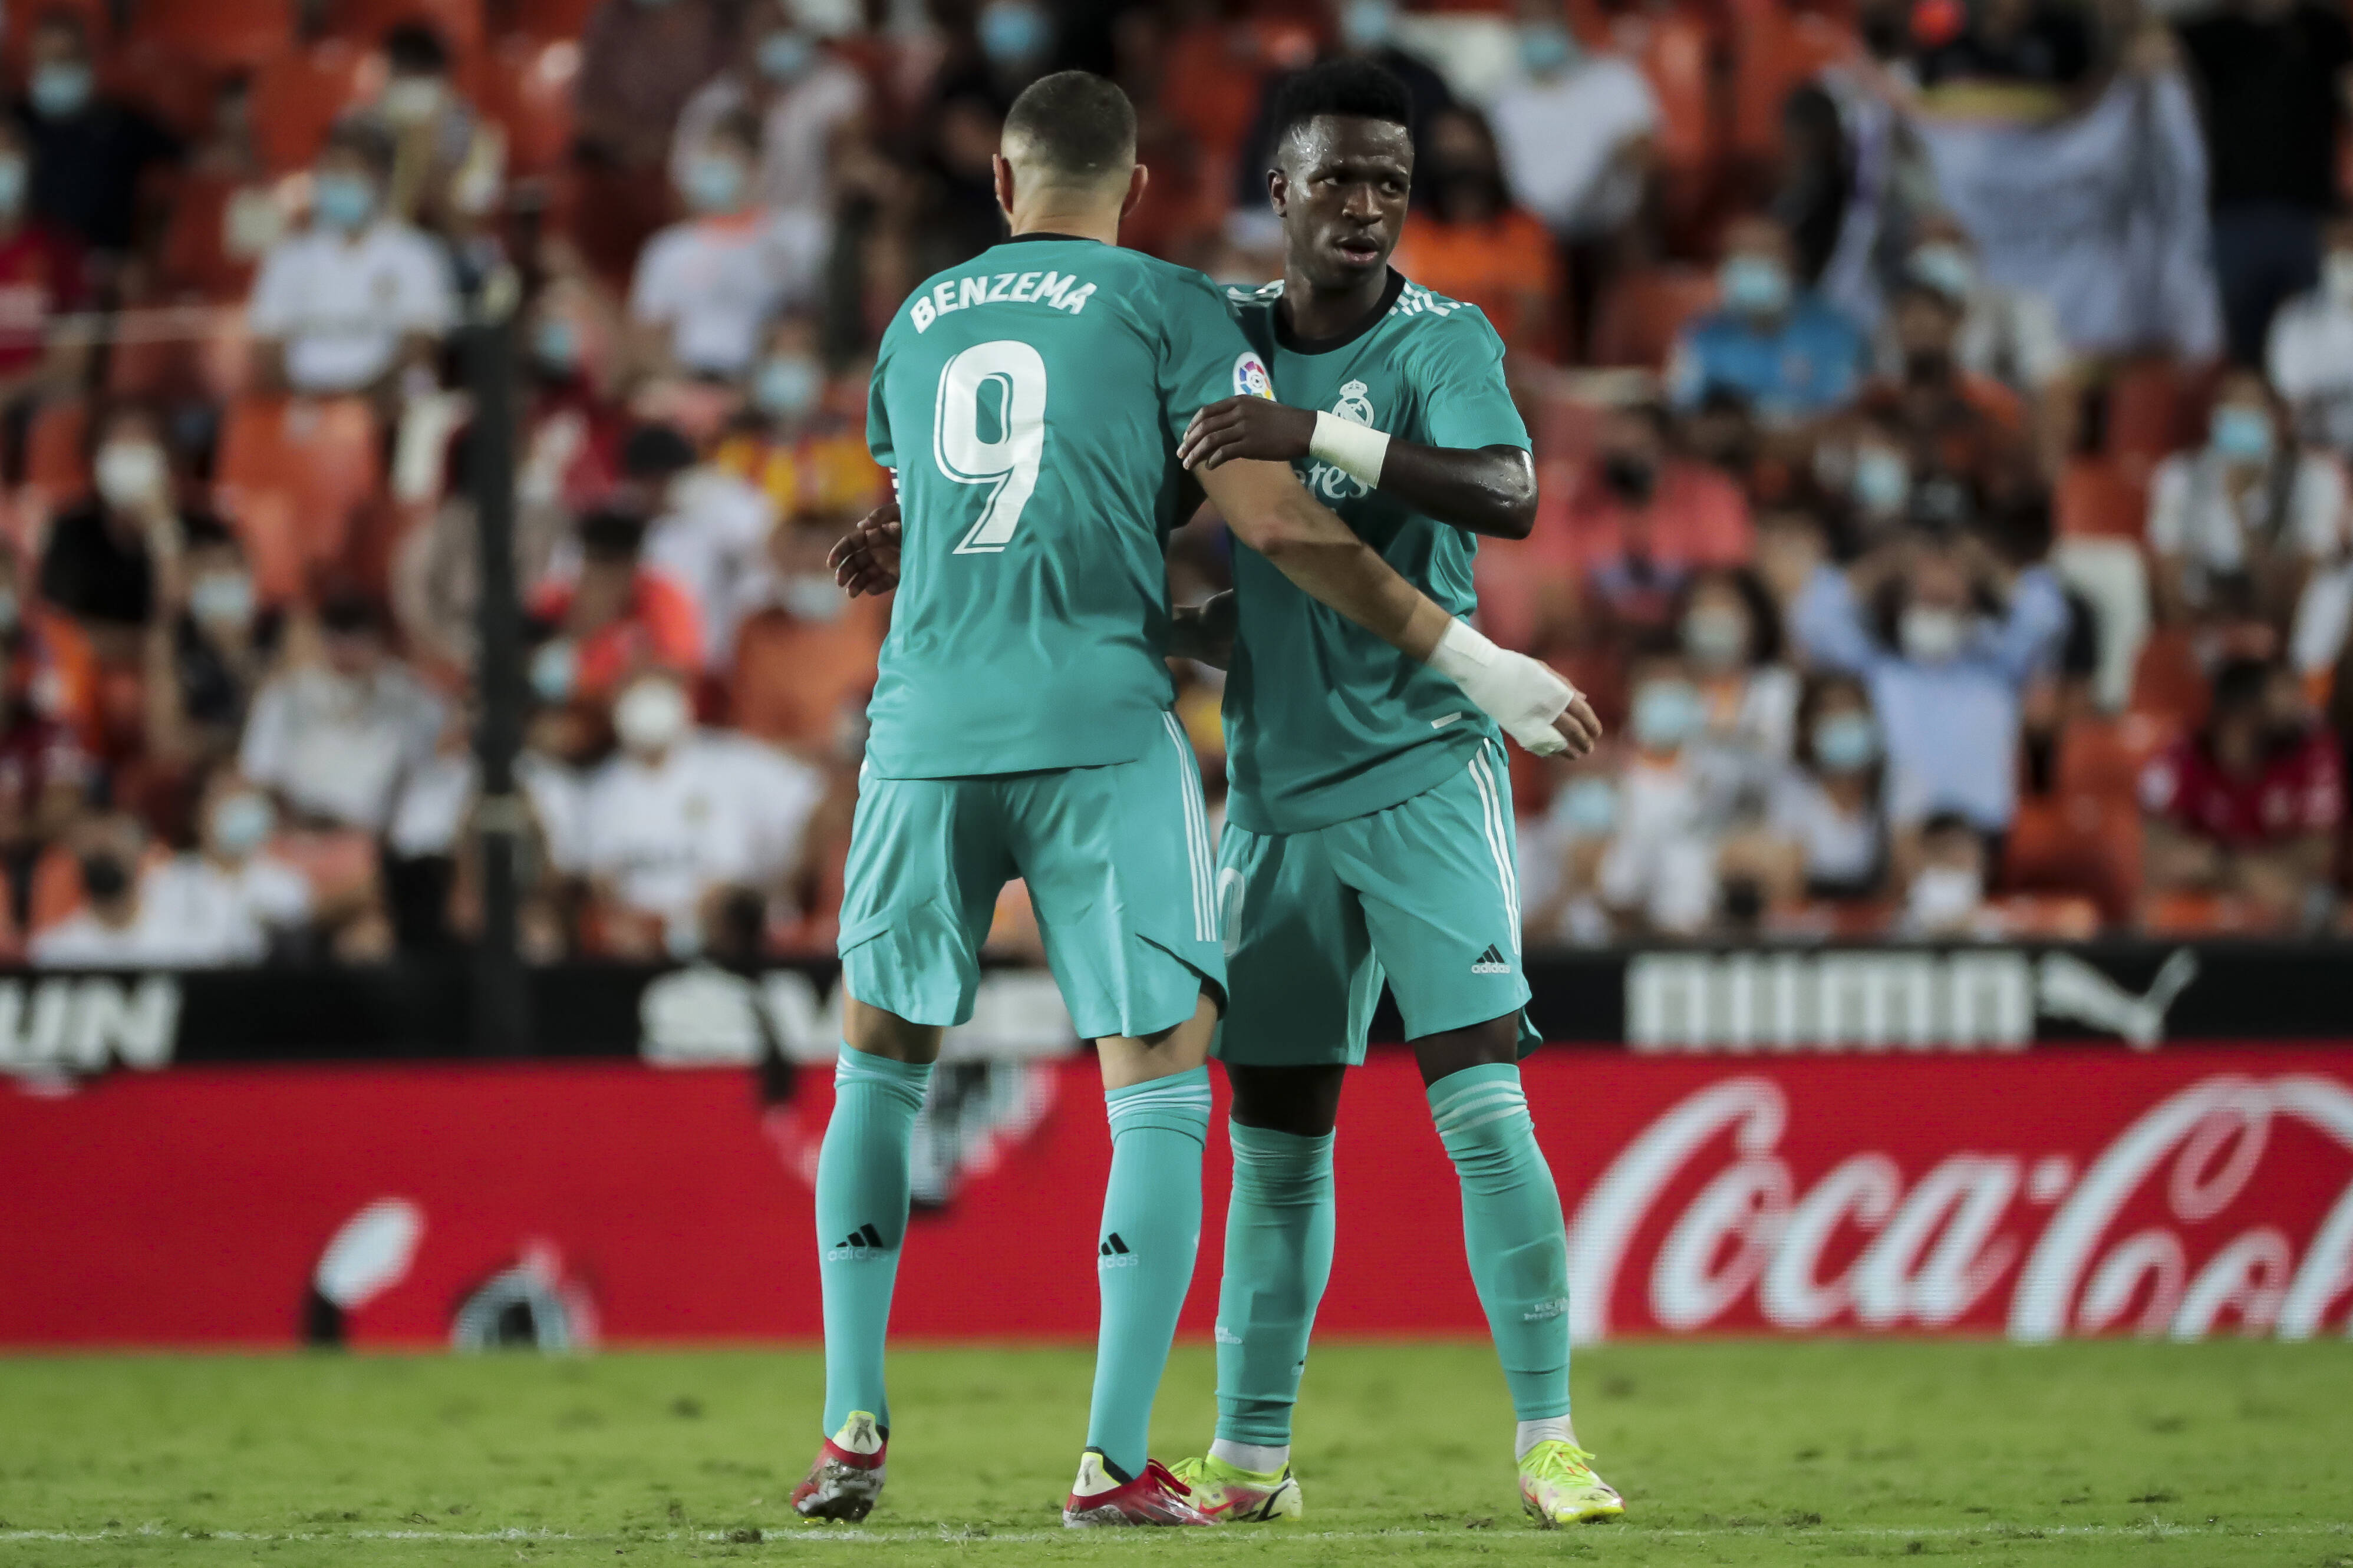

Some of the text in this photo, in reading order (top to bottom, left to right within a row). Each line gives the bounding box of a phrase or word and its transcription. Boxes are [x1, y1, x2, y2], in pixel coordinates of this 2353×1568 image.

[909, 270, 1098, 334] BENZEMA
[934, 340, 1047, 554] 9
[1471, 960, 1510, 974] adidas
